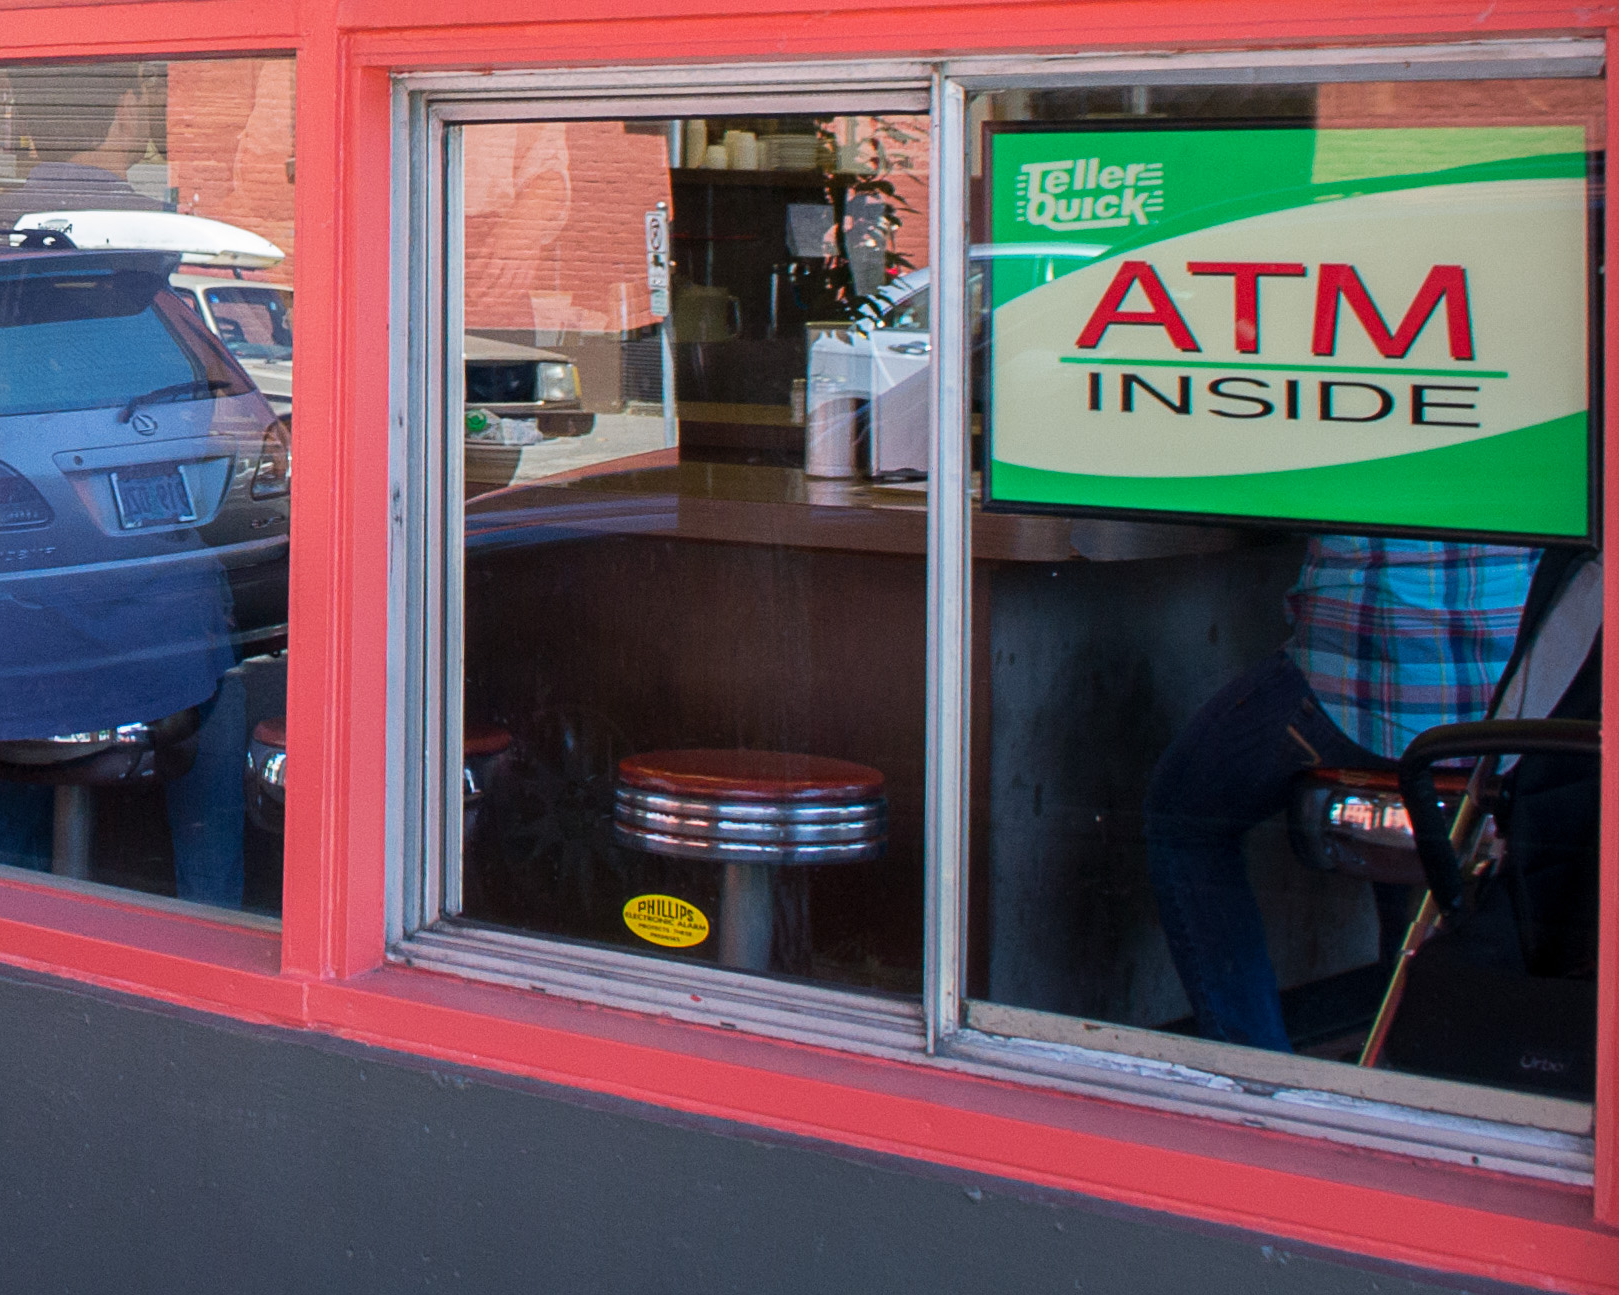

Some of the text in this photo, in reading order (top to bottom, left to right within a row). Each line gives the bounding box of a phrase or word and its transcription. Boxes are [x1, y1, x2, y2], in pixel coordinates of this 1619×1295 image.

[1021, 157, 1148, 199] Teller
[1026, 187, 1150, 232] Quick
[1074, 260, 1476, 361] ATM
[1087, 371, 1481, 428] INSIDE
[624, 911, 706, 931] ELECTRONIC ALARM
[637, 899, 694, 922] PHILLIPS
